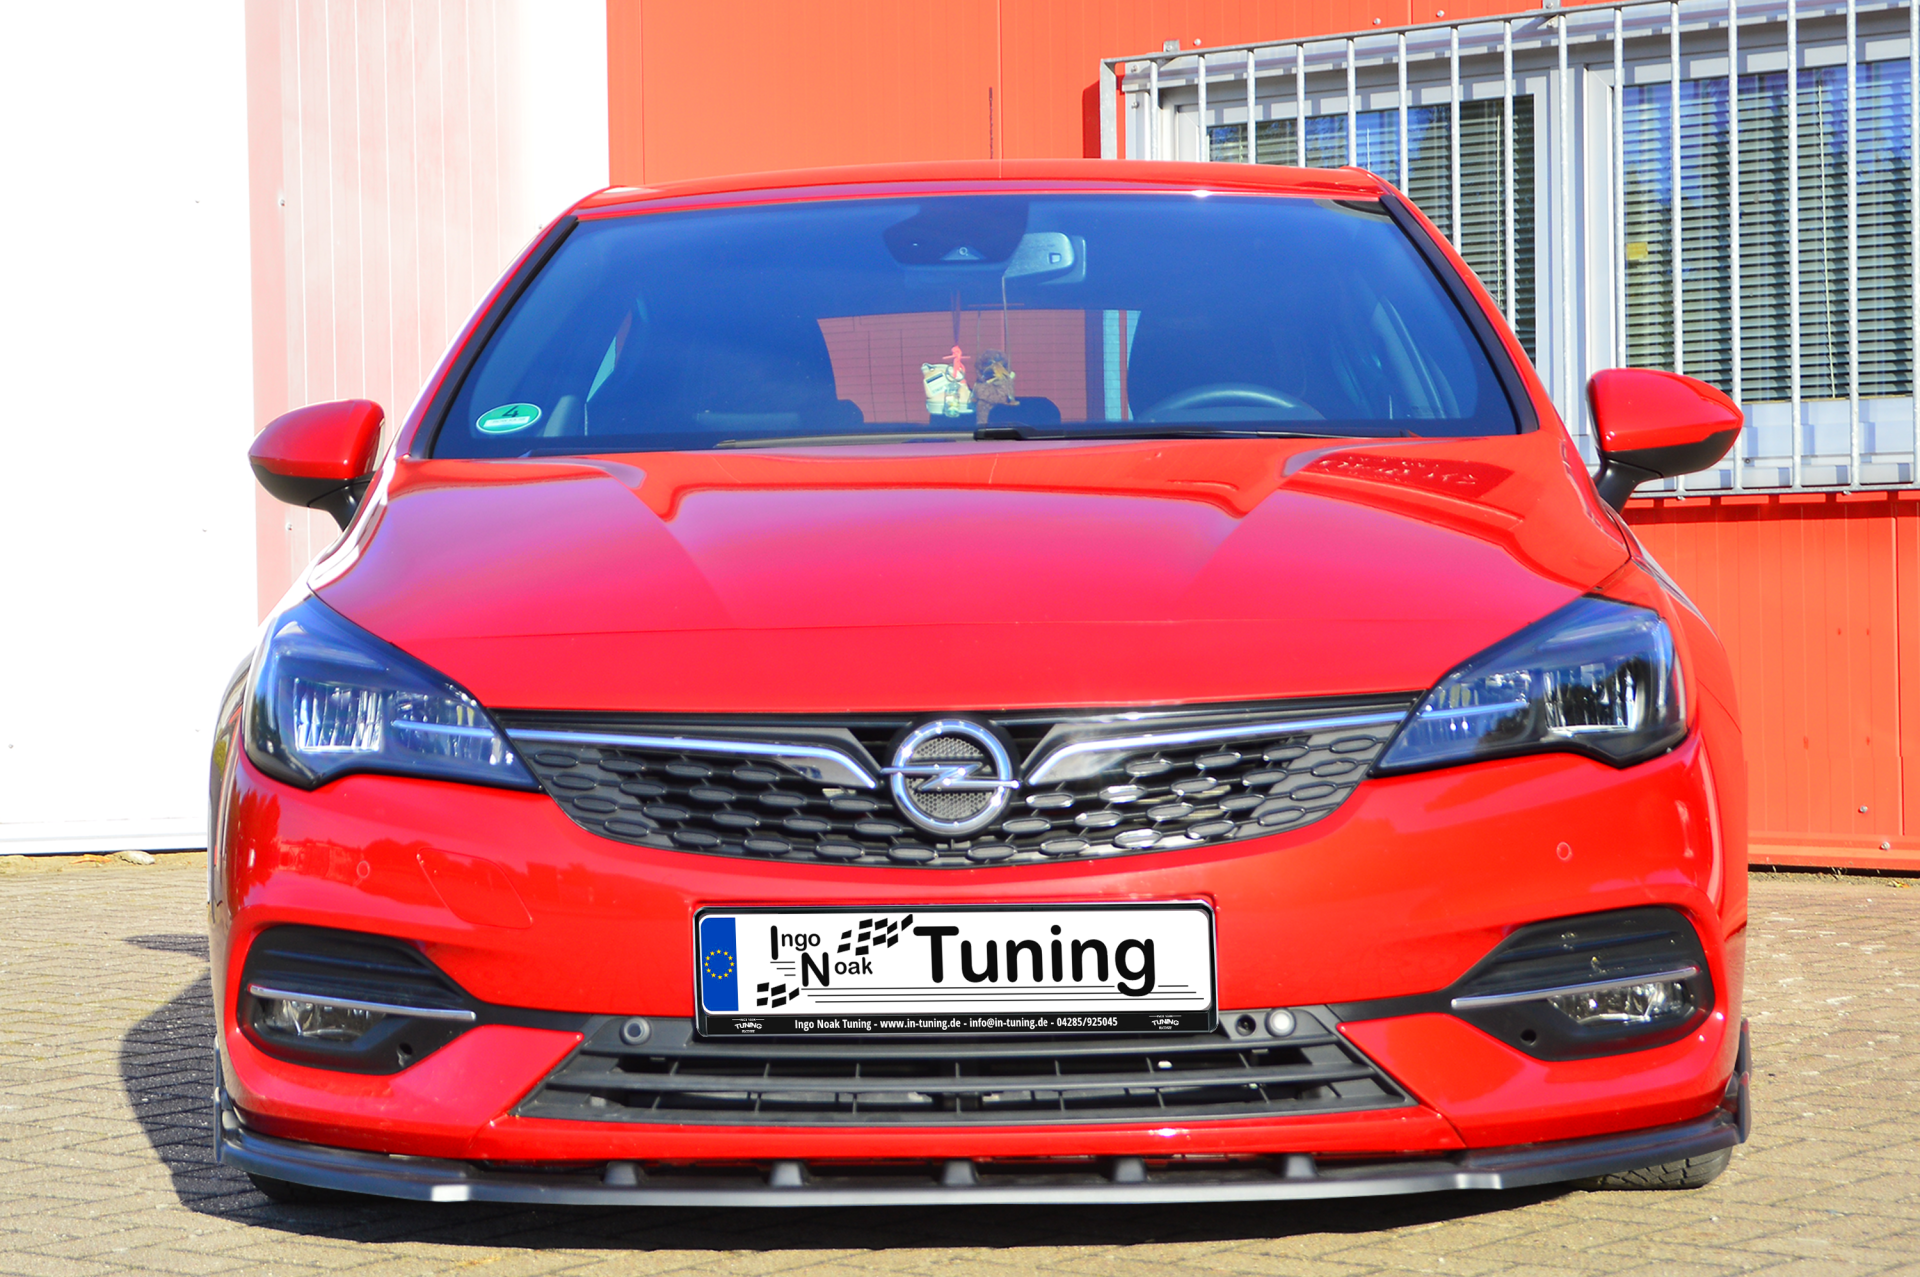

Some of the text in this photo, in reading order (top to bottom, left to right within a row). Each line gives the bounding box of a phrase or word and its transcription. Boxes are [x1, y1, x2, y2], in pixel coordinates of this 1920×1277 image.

[502, 405, 519, 418] 4
[770, 925, 821, 960] Ingo
[913, 924, 1156, 997] Tuning
[801, 952, 873, 987] Noak
[734, 1022, 763, 1030] TUNING
[794, 1019, 815, 1032] Ingo
[817, 1019, 841, 1029] Noak
[842, 1018, 872, 1031] Tuning
[879, 1018, 961, 1031] www.in-tuning.de
[969, 1017, 1048, 1030] info@in-tuning.de
[1056, 1016, 1118, 1028] 04285/925045
[1151, 1018, 1180, 1026] TUNING
